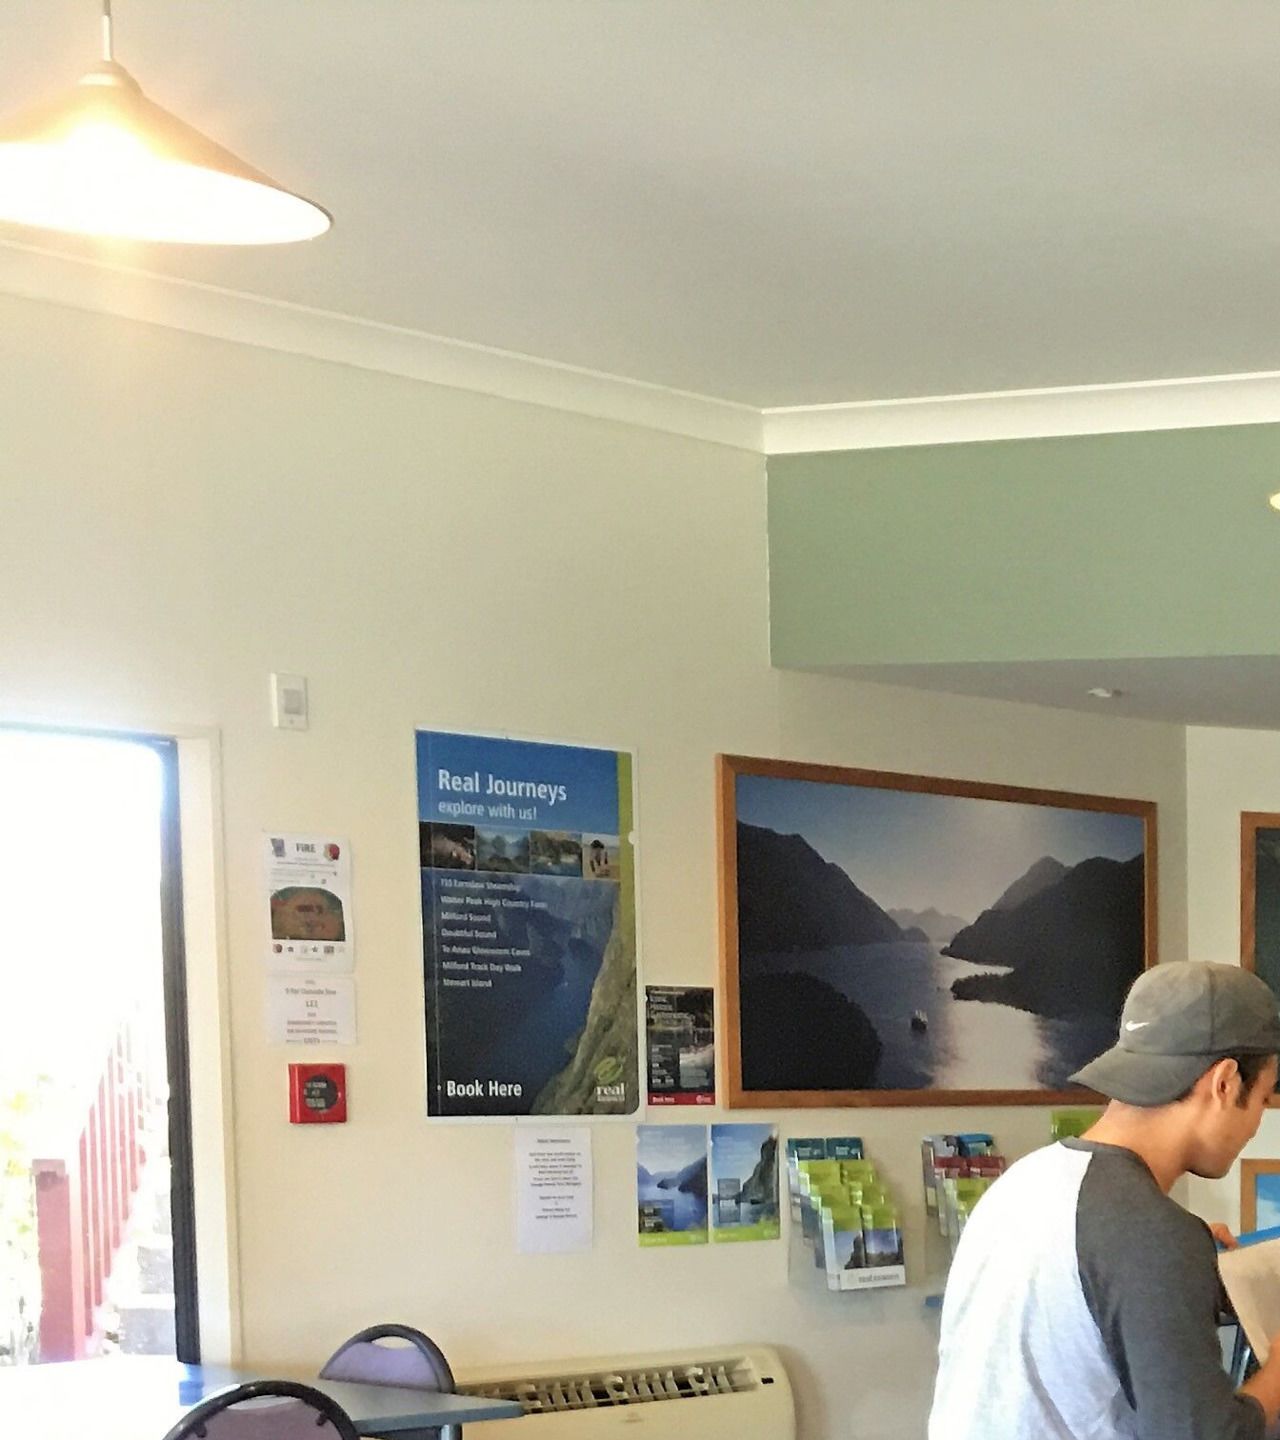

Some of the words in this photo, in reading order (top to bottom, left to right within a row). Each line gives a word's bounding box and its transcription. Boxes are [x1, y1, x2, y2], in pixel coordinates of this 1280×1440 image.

[438, 769, 480, 793] Real
[486, 774, 567, 806] Journeys
[438, 799, 484, 817] explore
[488, 803, 515, 819] with
[519, 806, 537, 820] us!
[446, 1079, 484, 1097] Book
[489, 1081, 522, 1097] Here
[596, 1083, 625, 1096] real
